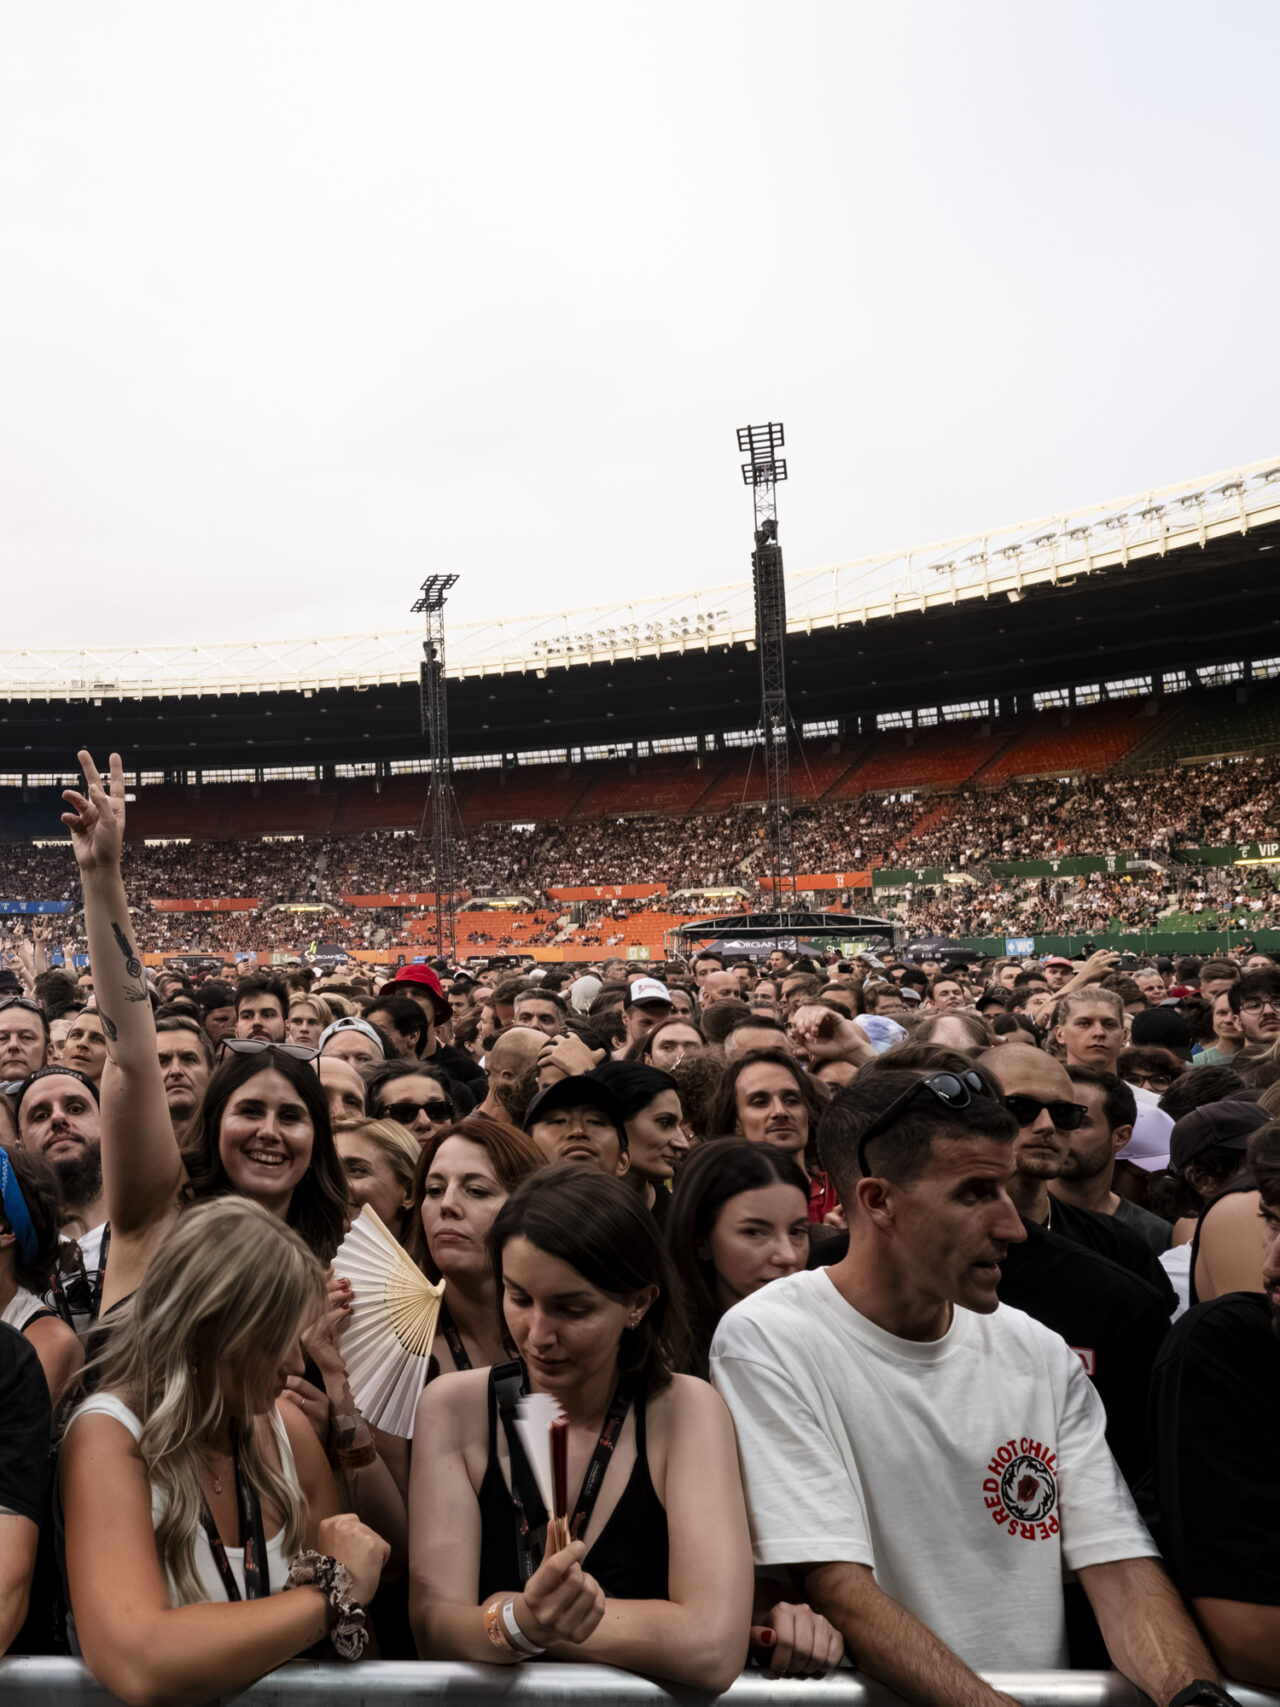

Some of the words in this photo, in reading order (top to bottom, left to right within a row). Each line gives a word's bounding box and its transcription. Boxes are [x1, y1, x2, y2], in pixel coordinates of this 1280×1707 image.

[1258, 842, 1279, 857] VIP
[1016, 940, 1034, 953] WC
[987, 1439, 1019, 1477] HOT
[1007, 1514, 1060, 1541] PERS
